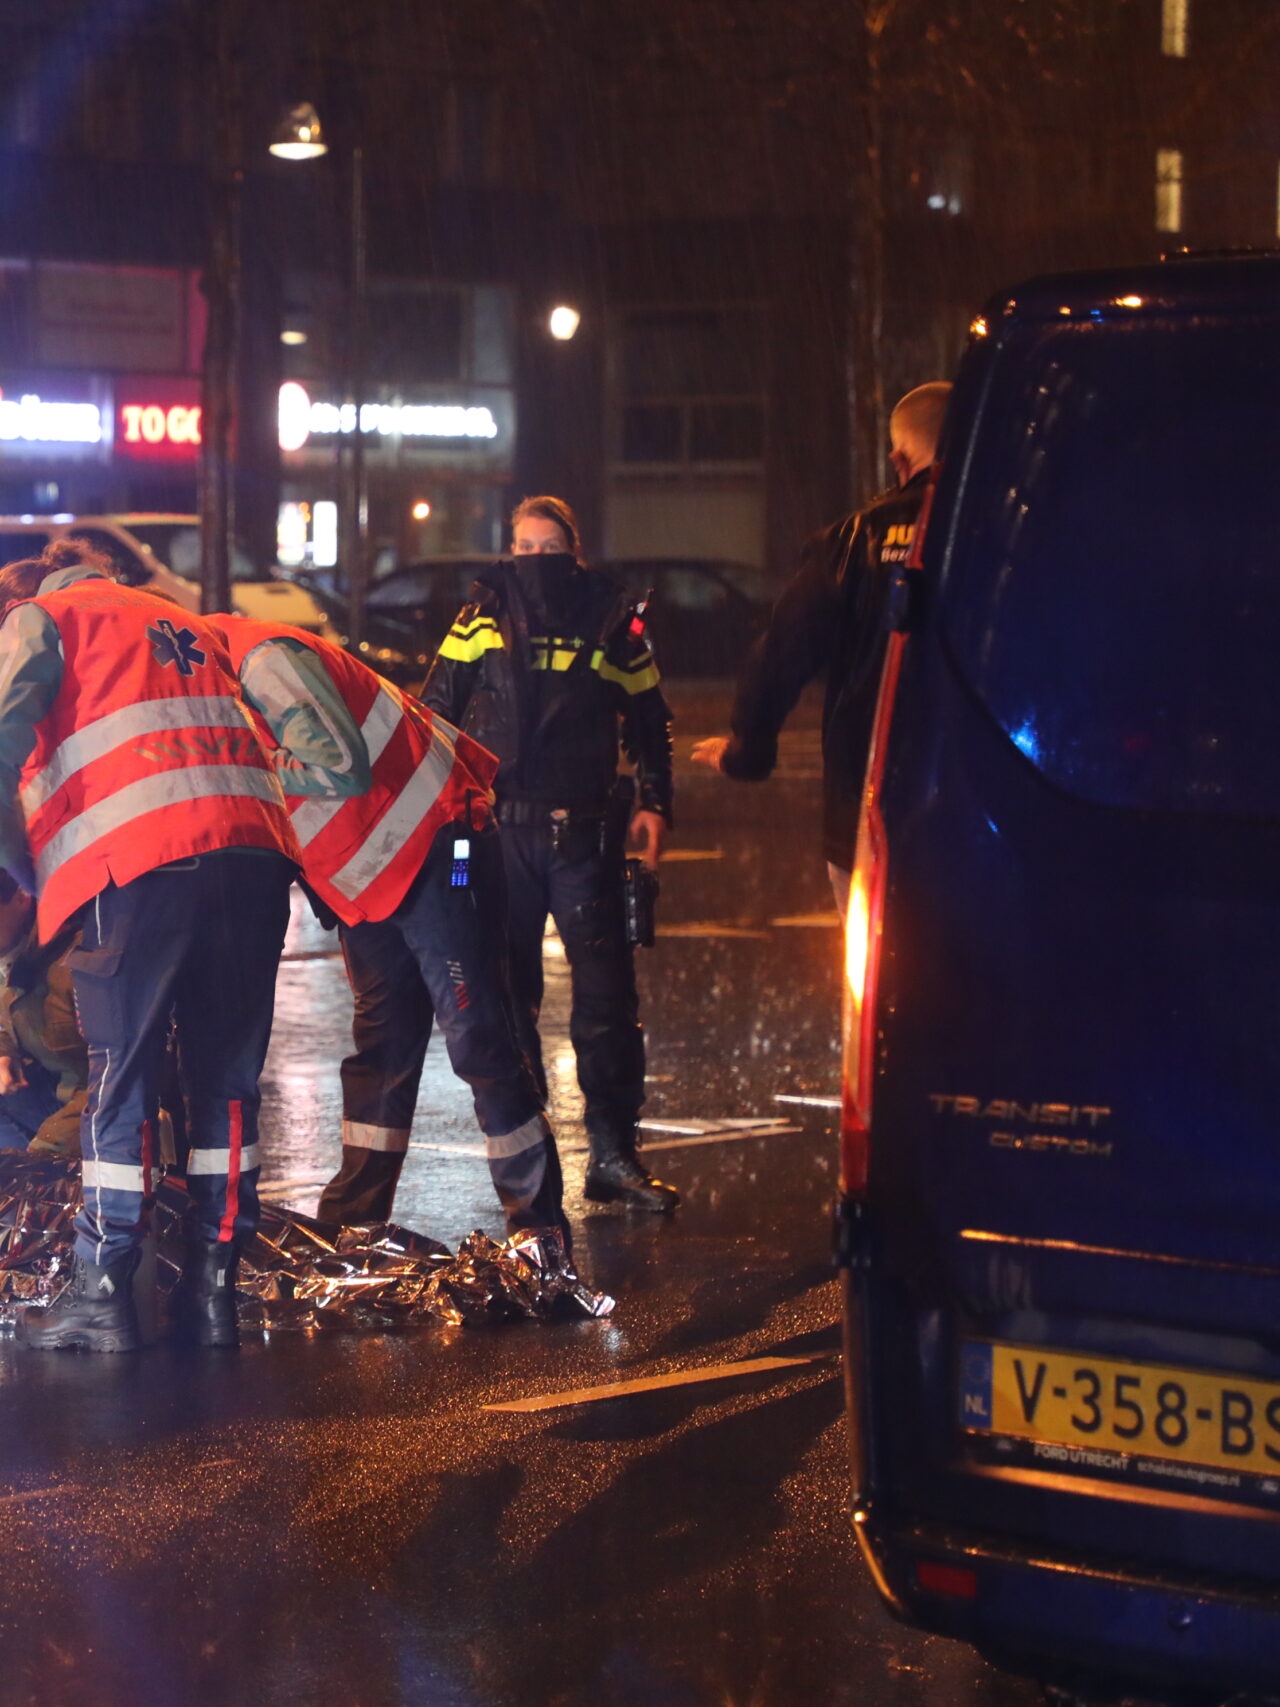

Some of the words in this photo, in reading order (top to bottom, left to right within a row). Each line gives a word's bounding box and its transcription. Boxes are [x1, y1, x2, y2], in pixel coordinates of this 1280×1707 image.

[929, 1093, 1112, 1127] TRANSIT
[990, 1131, 1112, 1156] CUSTOM
[964, 1393, 989, 1416] NL
[1033, 1444, 1069, 1461] FORD
[1070, 1449, 1129, 1471] UTRECHT
